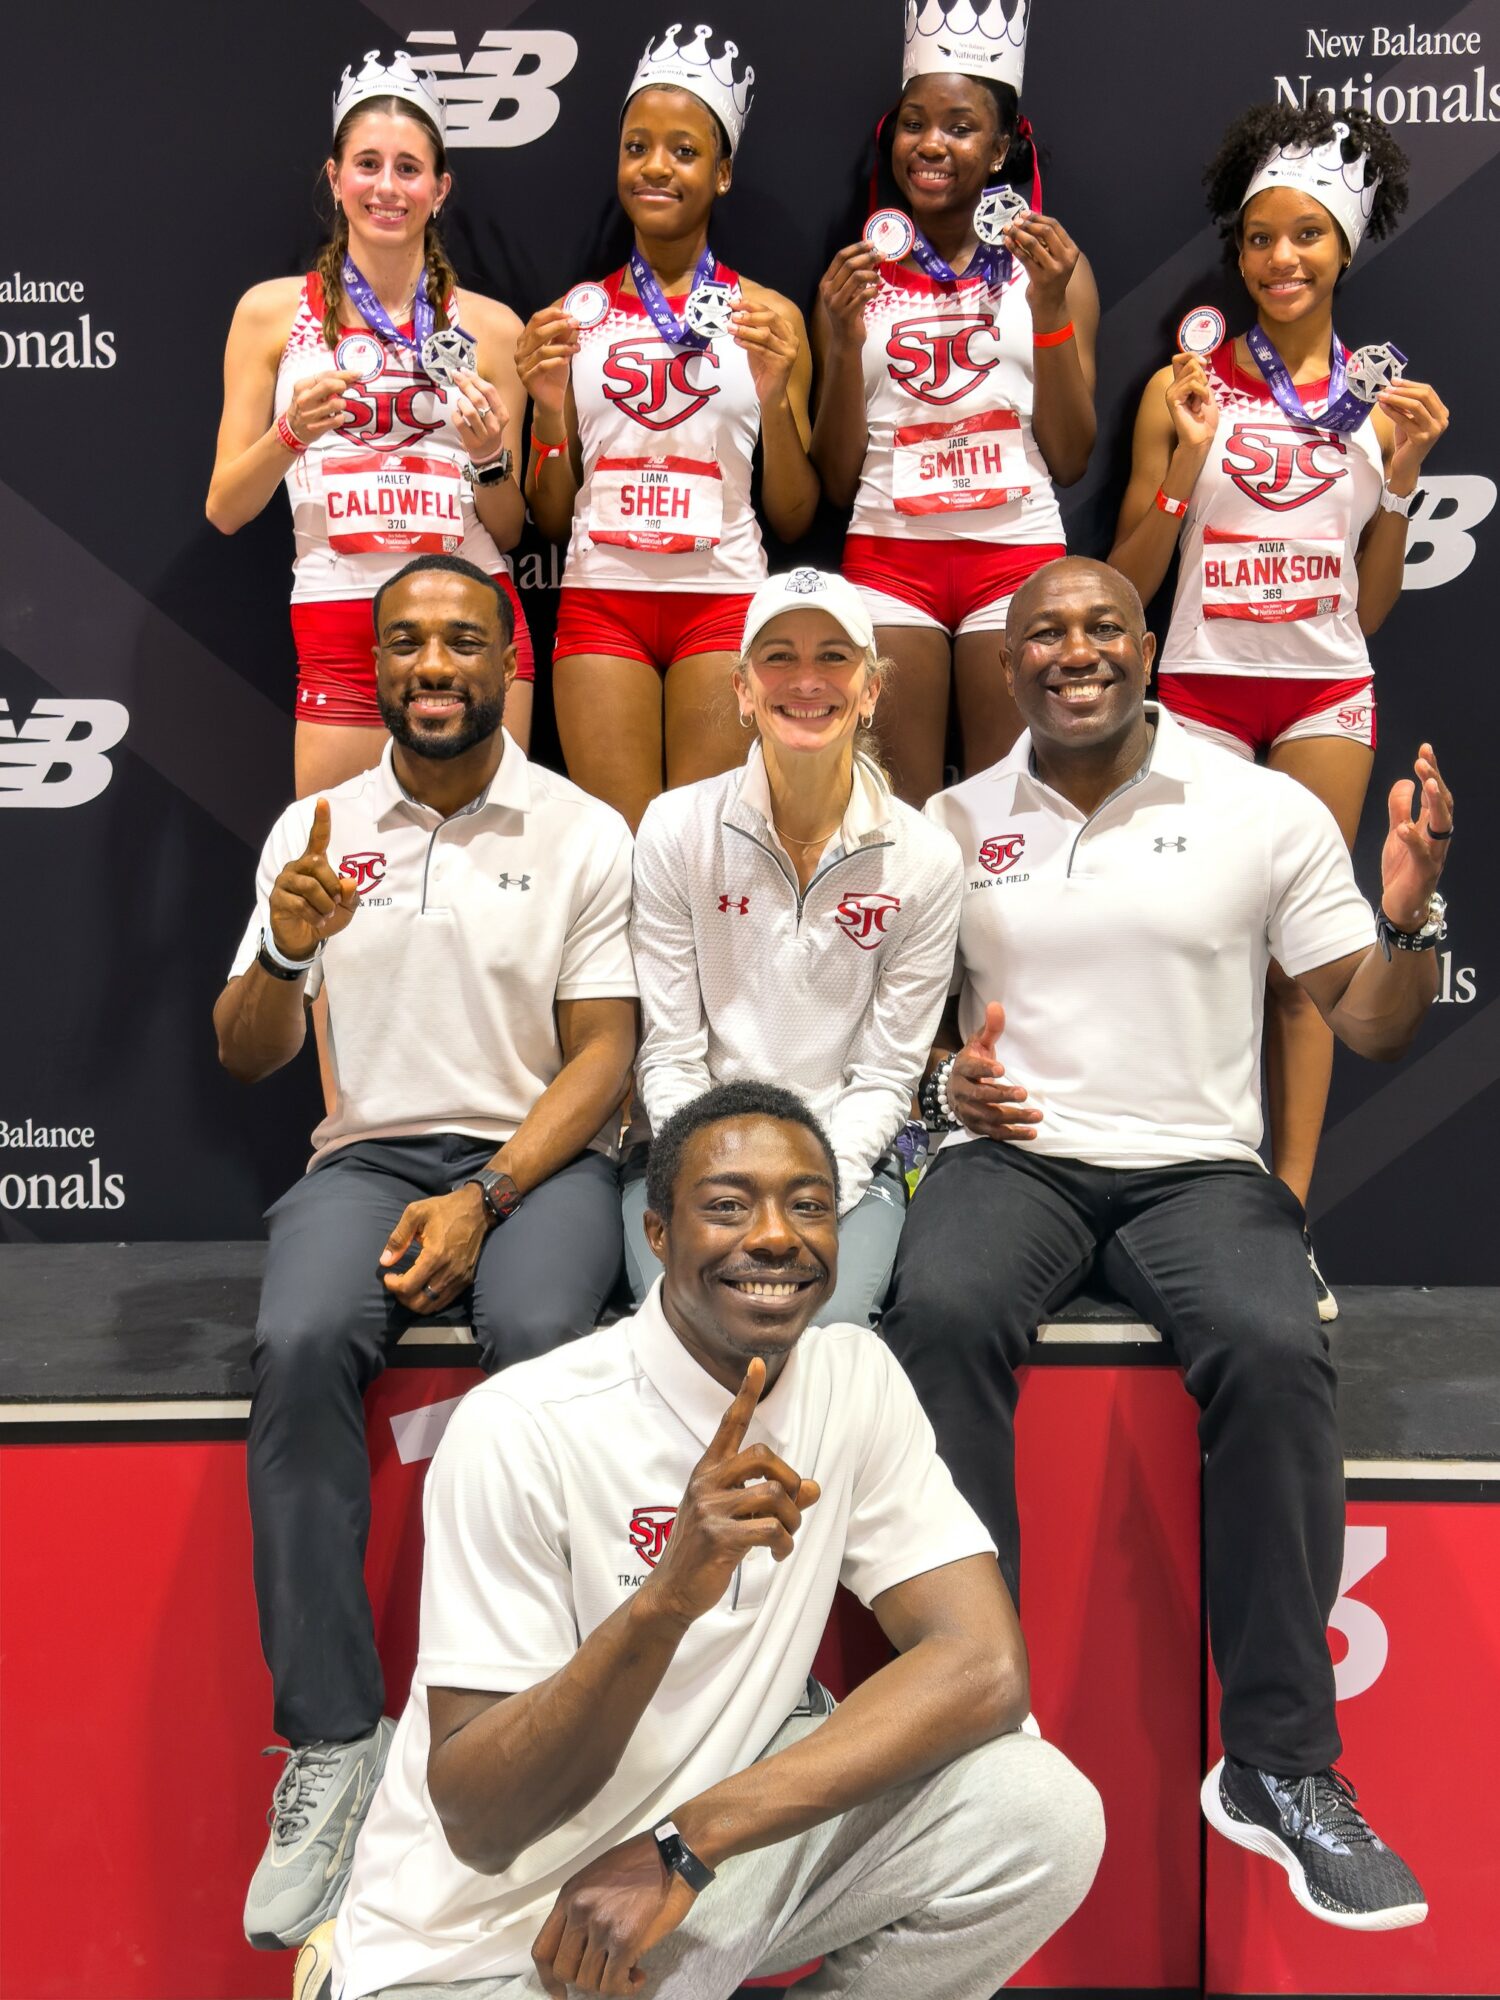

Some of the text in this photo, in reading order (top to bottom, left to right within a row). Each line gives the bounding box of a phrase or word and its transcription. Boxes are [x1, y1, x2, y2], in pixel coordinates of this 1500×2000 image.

[1306, 24, 1481, 58] New Balance
[954, 50, 989, 62] Nationals
[886, 325, 1000, 391] SJC
[602, 350, 721, 414] SJC
[947, 436, 969, 449] JADE
[920, 444, 1002, 480] SMITH
[1222, 433, 1349, 493] SJC
[377, 474, 411, 485] HAILEY
[641, 472, 669, 483] LIANA
[952, 478, 971, 489] 382
[327, 488, 461, 520] CALDWELL
[620, 485, 691, 519] SHEH
[387, 519, 407, 530] 370
[1258, 542, 1286, 553] ALVIA
[1205, 555, 1341, 587] BLANKSON
[1263, 588, 1282, 600] 369
[1337, 709, 1367, 728] SJC
[979, 839, 1026, 867] SJC
[338, 858, 387, 887] SJC
[970, 873, 1030, 890] TRACK & FIELD
[369, 897, 393, 907] FIELD
[835, 901, 902, 937] SJC
